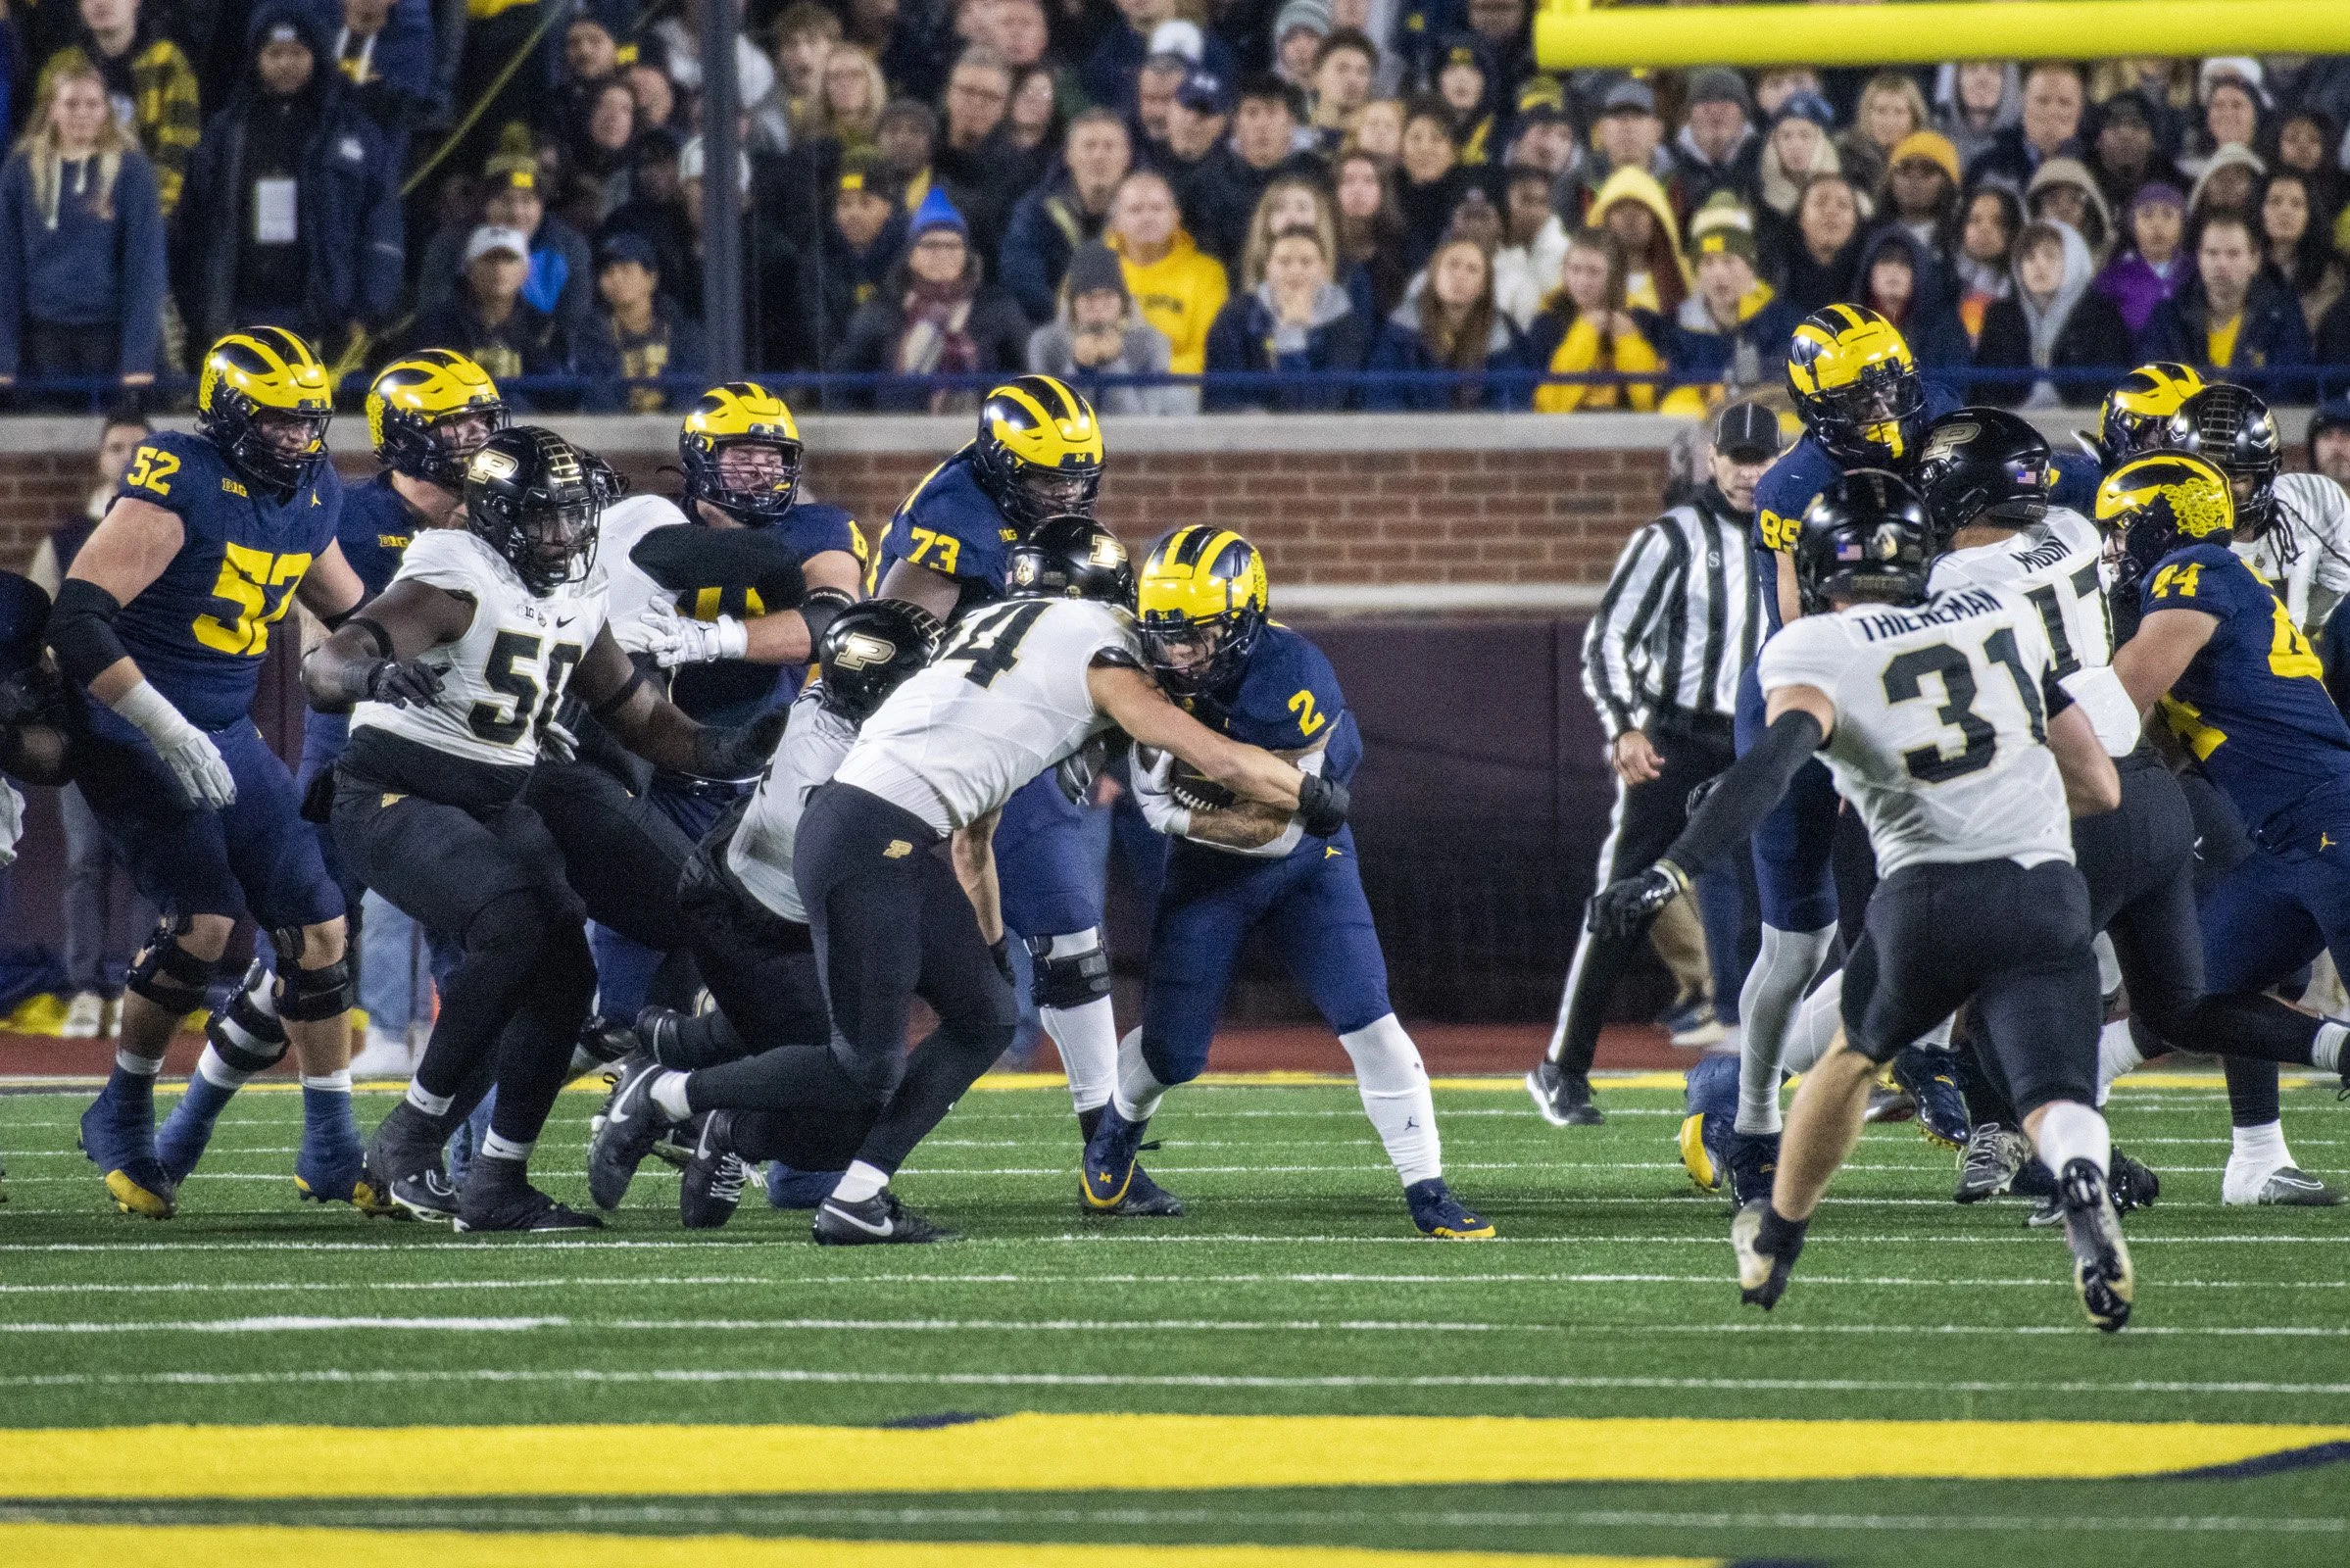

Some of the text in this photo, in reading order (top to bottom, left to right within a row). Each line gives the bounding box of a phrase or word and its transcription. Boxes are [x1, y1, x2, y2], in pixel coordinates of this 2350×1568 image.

[1921, 422, 1982, 462] P
[127, 446, 181, 496] 52
[467, 448, 519, 484] P
[907, 526, 960, 574] 73
[1087, 534, 1128, 569] P
[1708, 551, 1722, 567] S
[2151, 563, 2205, 599] 44
[834, 632, 897, 671] P
[1288, 689, 1326, 737] 2
[1881, 623, 2049, 785] 31
